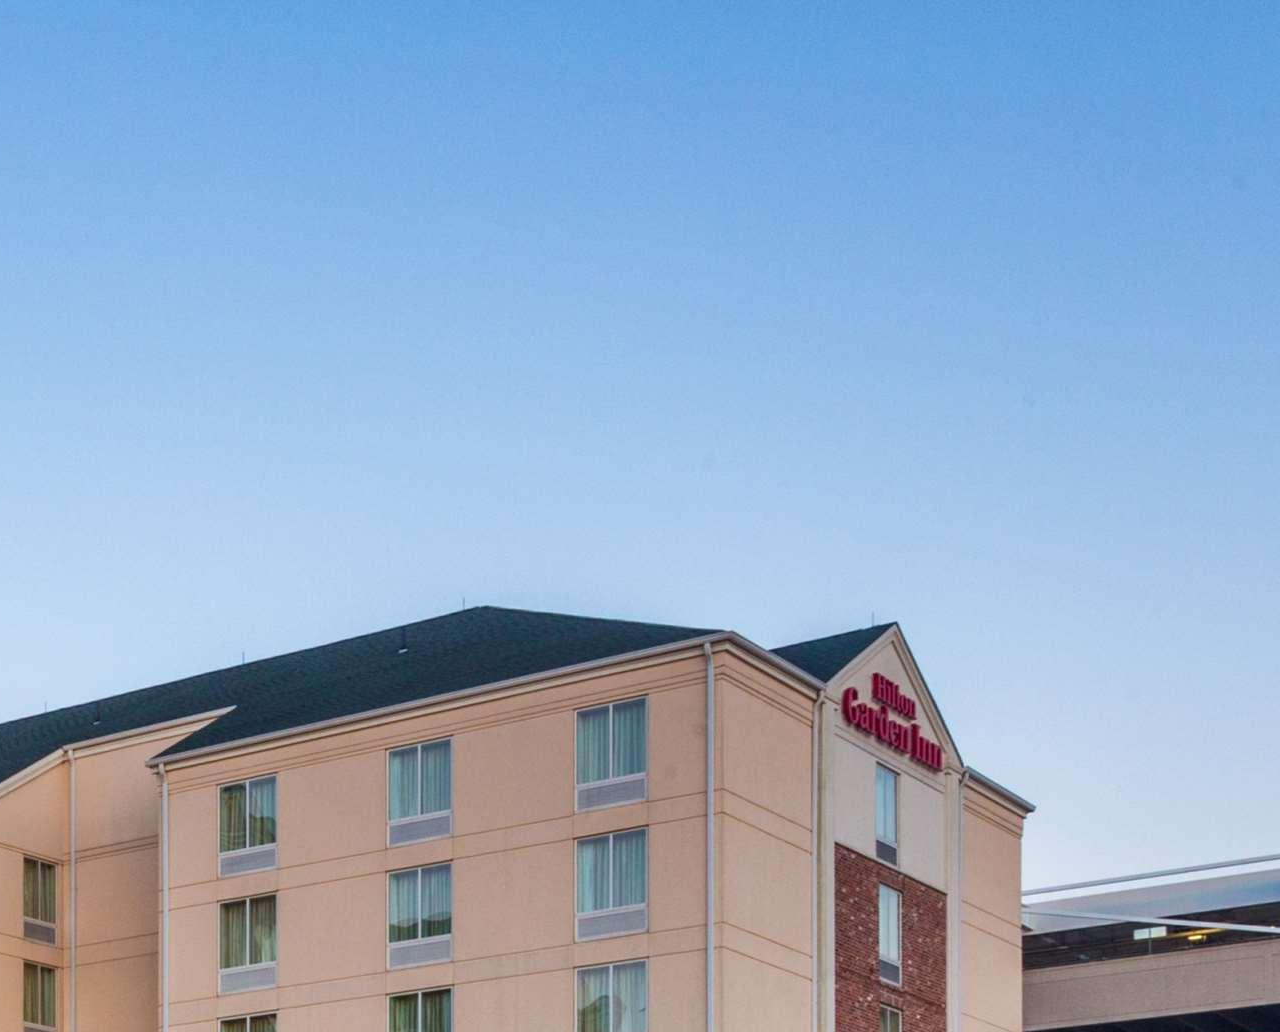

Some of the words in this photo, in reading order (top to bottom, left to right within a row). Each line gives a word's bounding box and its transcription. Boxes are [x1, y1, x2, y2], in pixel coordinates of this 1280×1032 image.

[842, 686, 910, 754] Garden
[909, 723, 943, 771] Inn
[872, 672, 916, 719] Hilton
